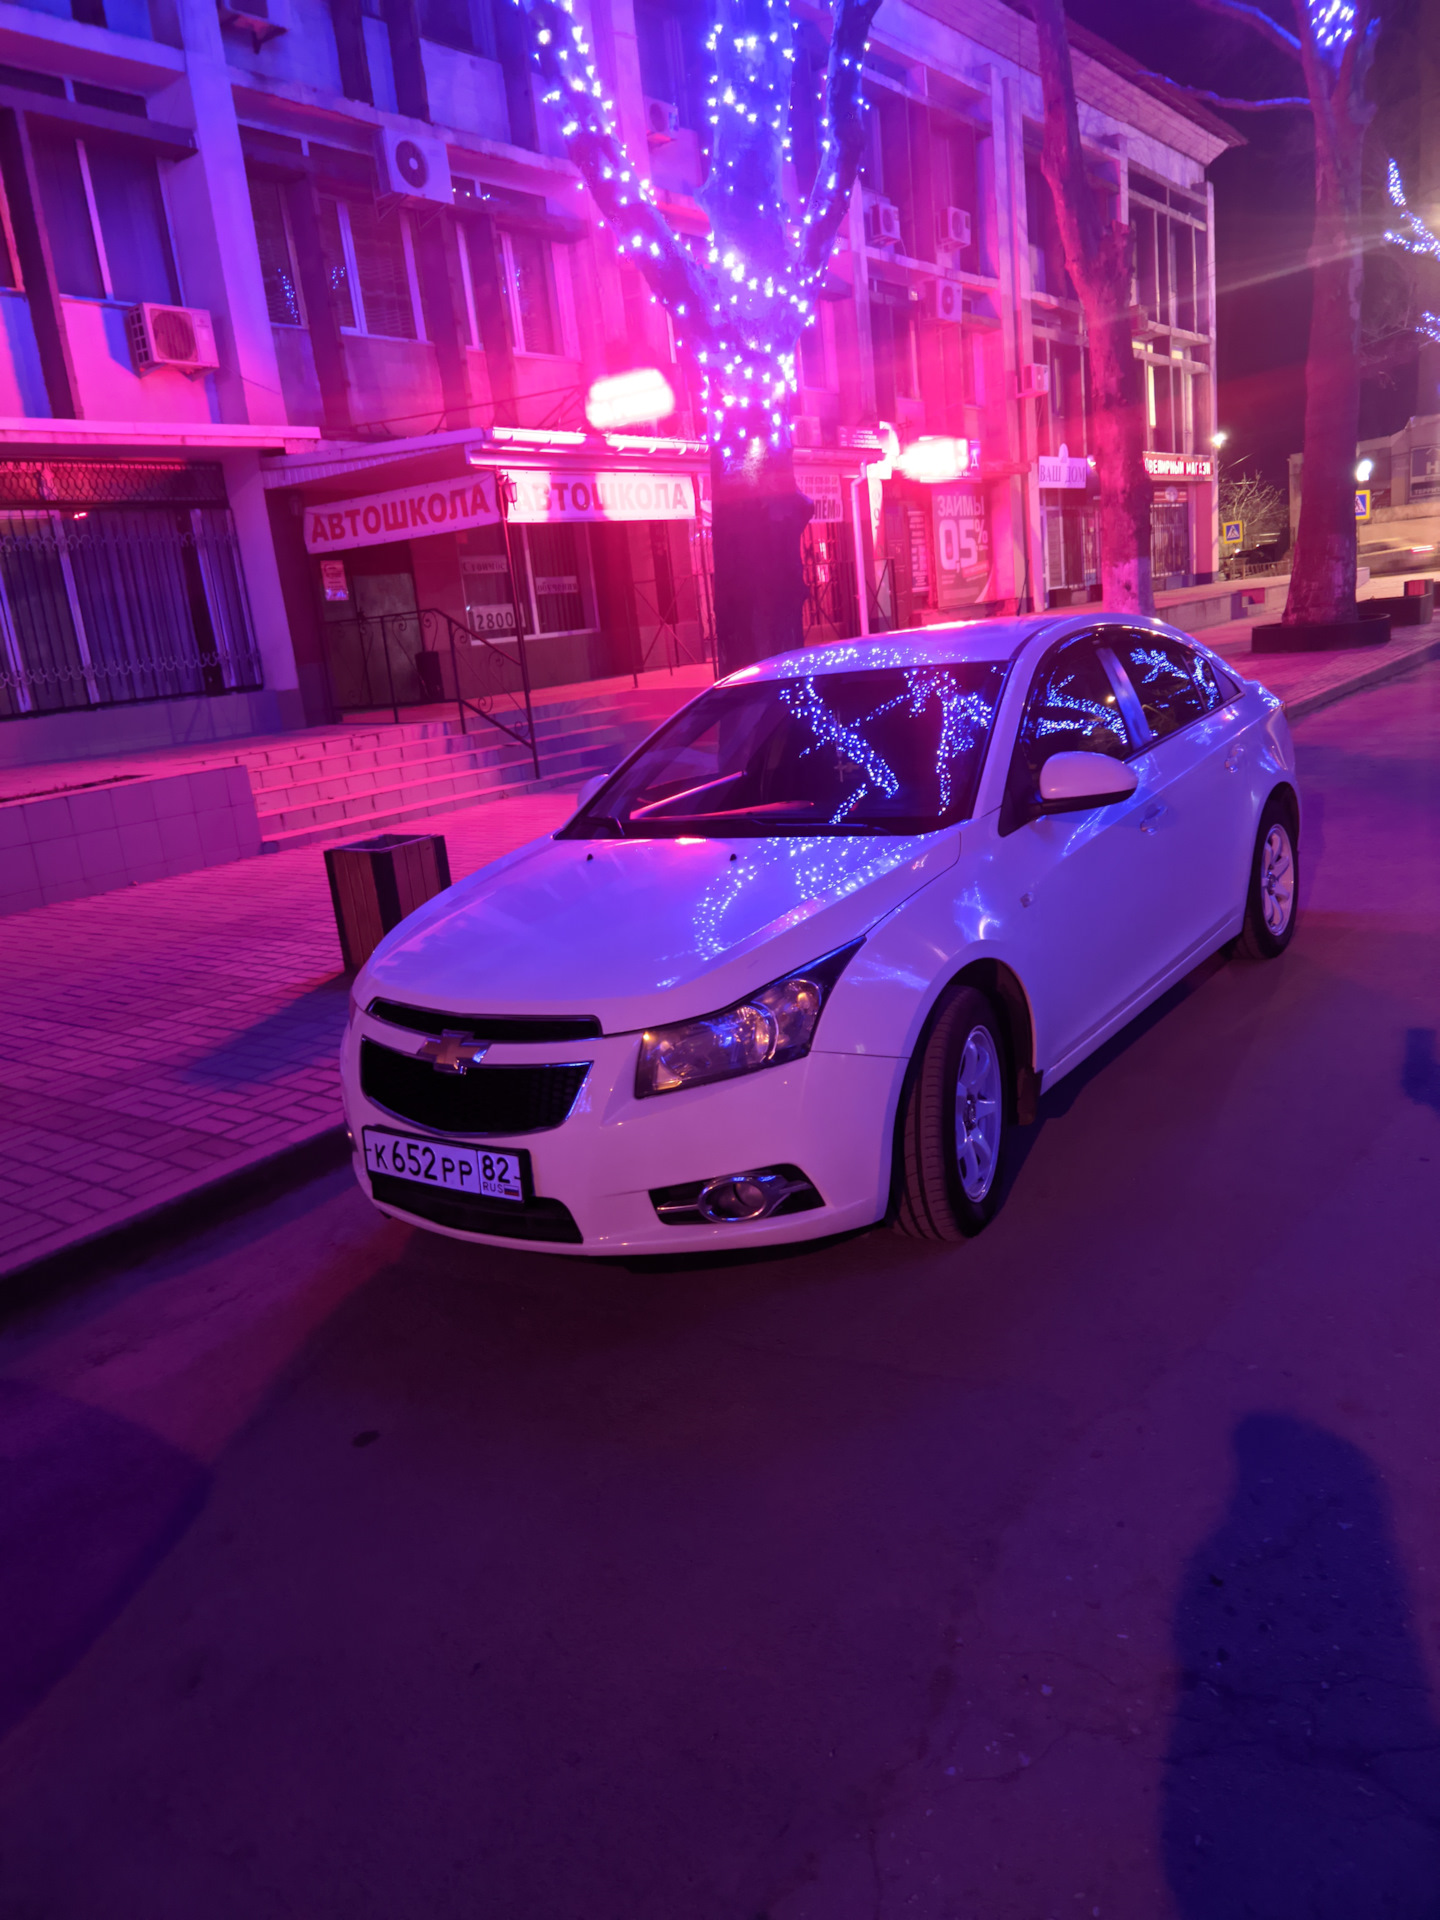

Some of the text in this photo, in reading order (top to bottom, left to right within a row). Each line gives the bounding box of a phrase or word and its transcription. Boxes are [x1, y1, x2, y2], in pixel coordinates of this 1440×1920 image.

[1040, 464, 1086, 485] ВАШ ДОМ
[517, 482, 689, 512] АВТОШКОЛА
[937, 492, 985, 517] ЗАЙМЫ
[311, 483, 491, 544] АВТОШКОЛА
[463, 561, 506, 572] Стоимос
[476, 612, 514, 630] 2800
[482, 1155, 511, 1184] 82
[483, 1182, 504, 1194] RUS
